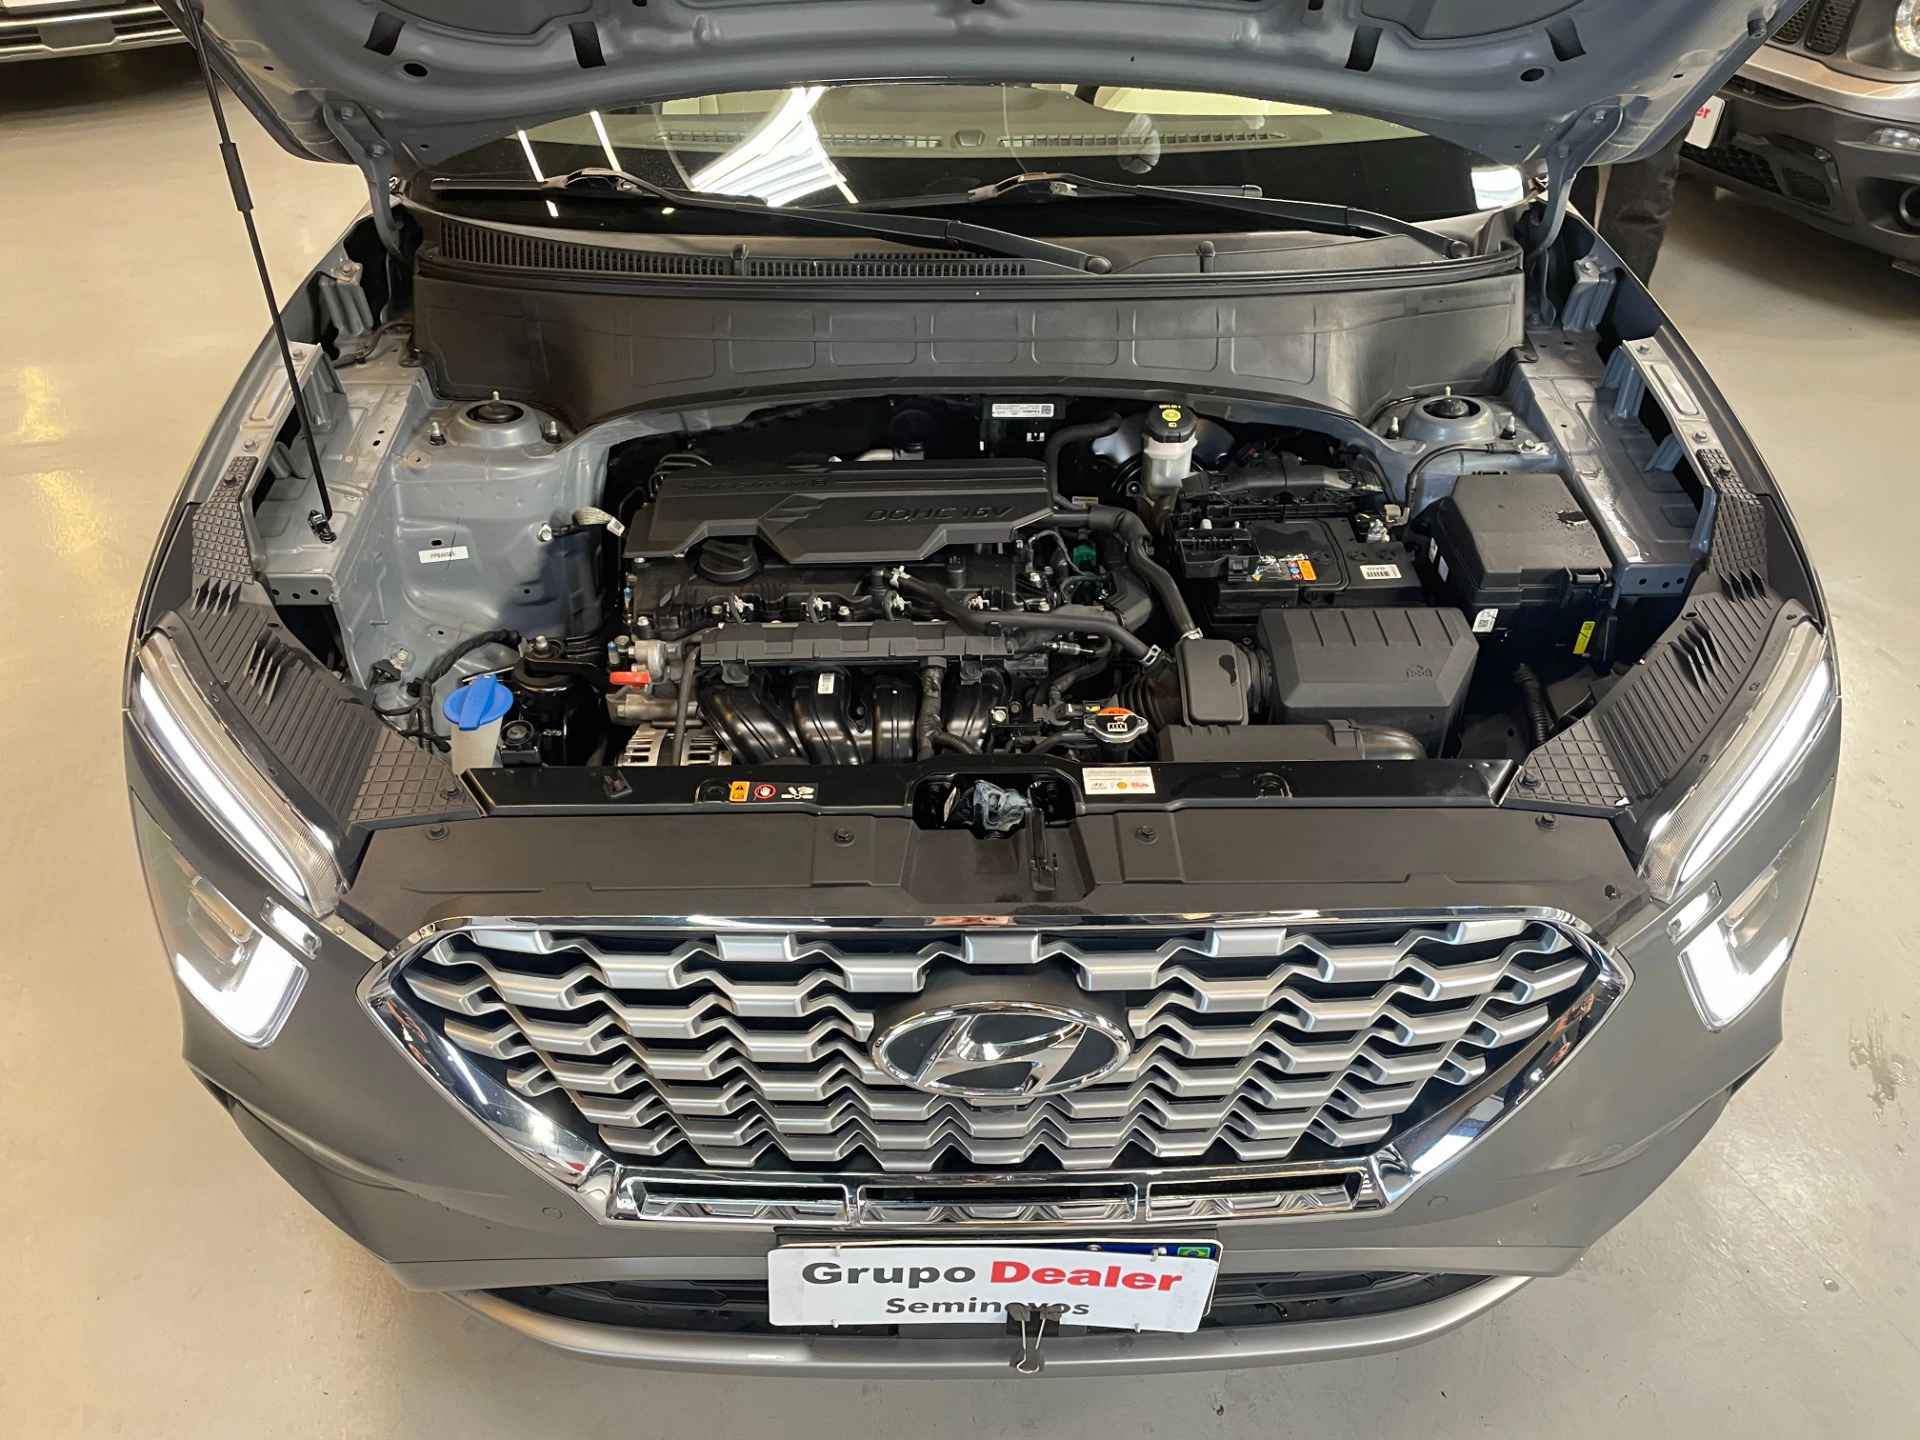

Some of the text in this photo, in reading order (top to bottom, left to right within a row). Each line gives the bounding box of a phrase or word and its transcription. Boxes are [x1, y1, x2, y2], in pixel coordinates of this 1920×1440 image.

[864, 505, 1016, 522] DOHC 16V
[802, 1261, 1183, 1291] Grupo Dealer
